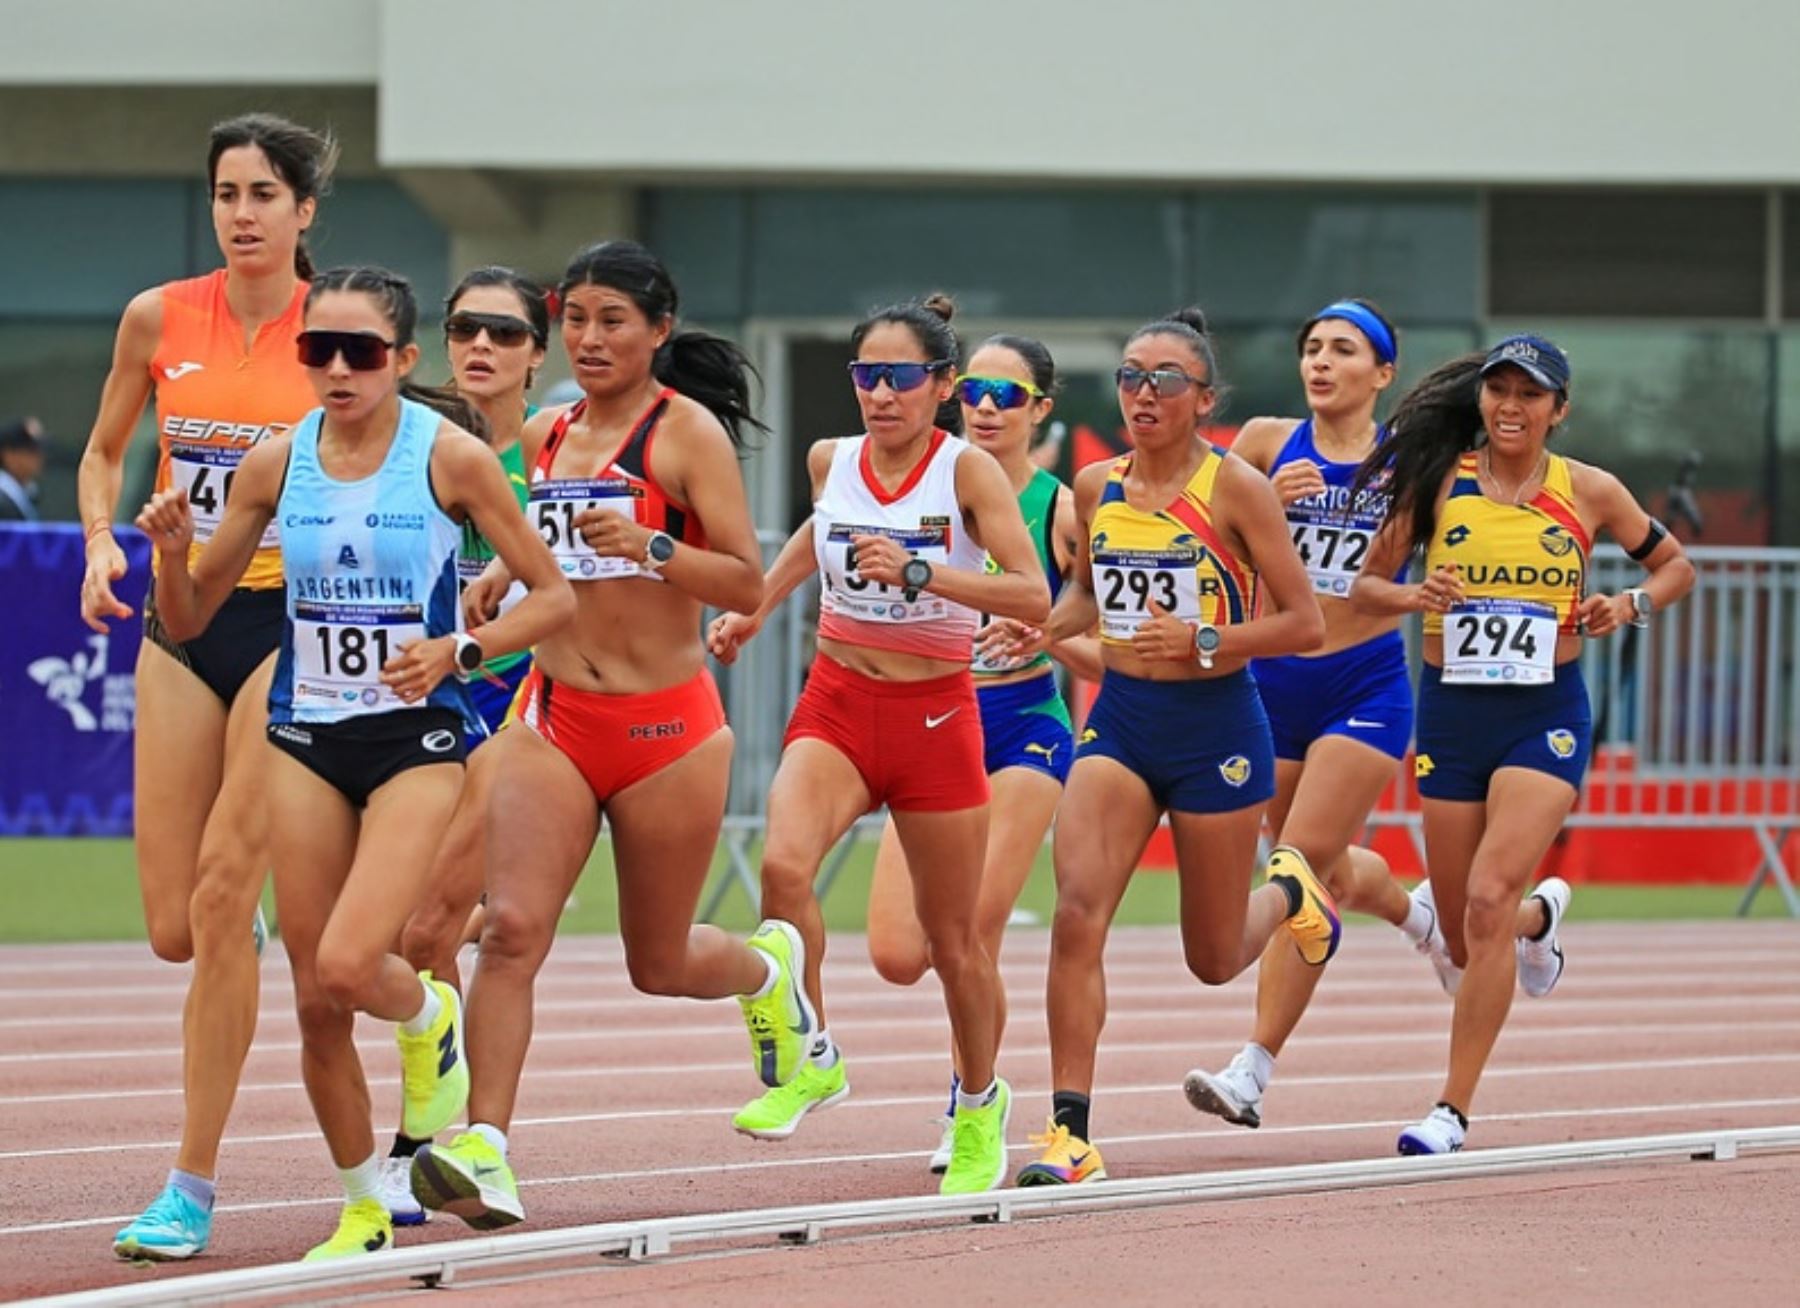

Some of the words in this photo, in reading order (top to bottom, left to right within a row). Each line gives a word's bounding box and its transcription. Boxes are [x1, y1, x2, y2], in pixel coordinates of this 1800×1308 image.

[1293, 525, 1369, 571] 472
[296, 576, 414, 602] ARGENTINA
[1103, 568, 1178, 612] 293
[316, 626, 388, 677] 181
[1456, 614, 1537, 660] 294
[629, 720, 685, 740] PERU
